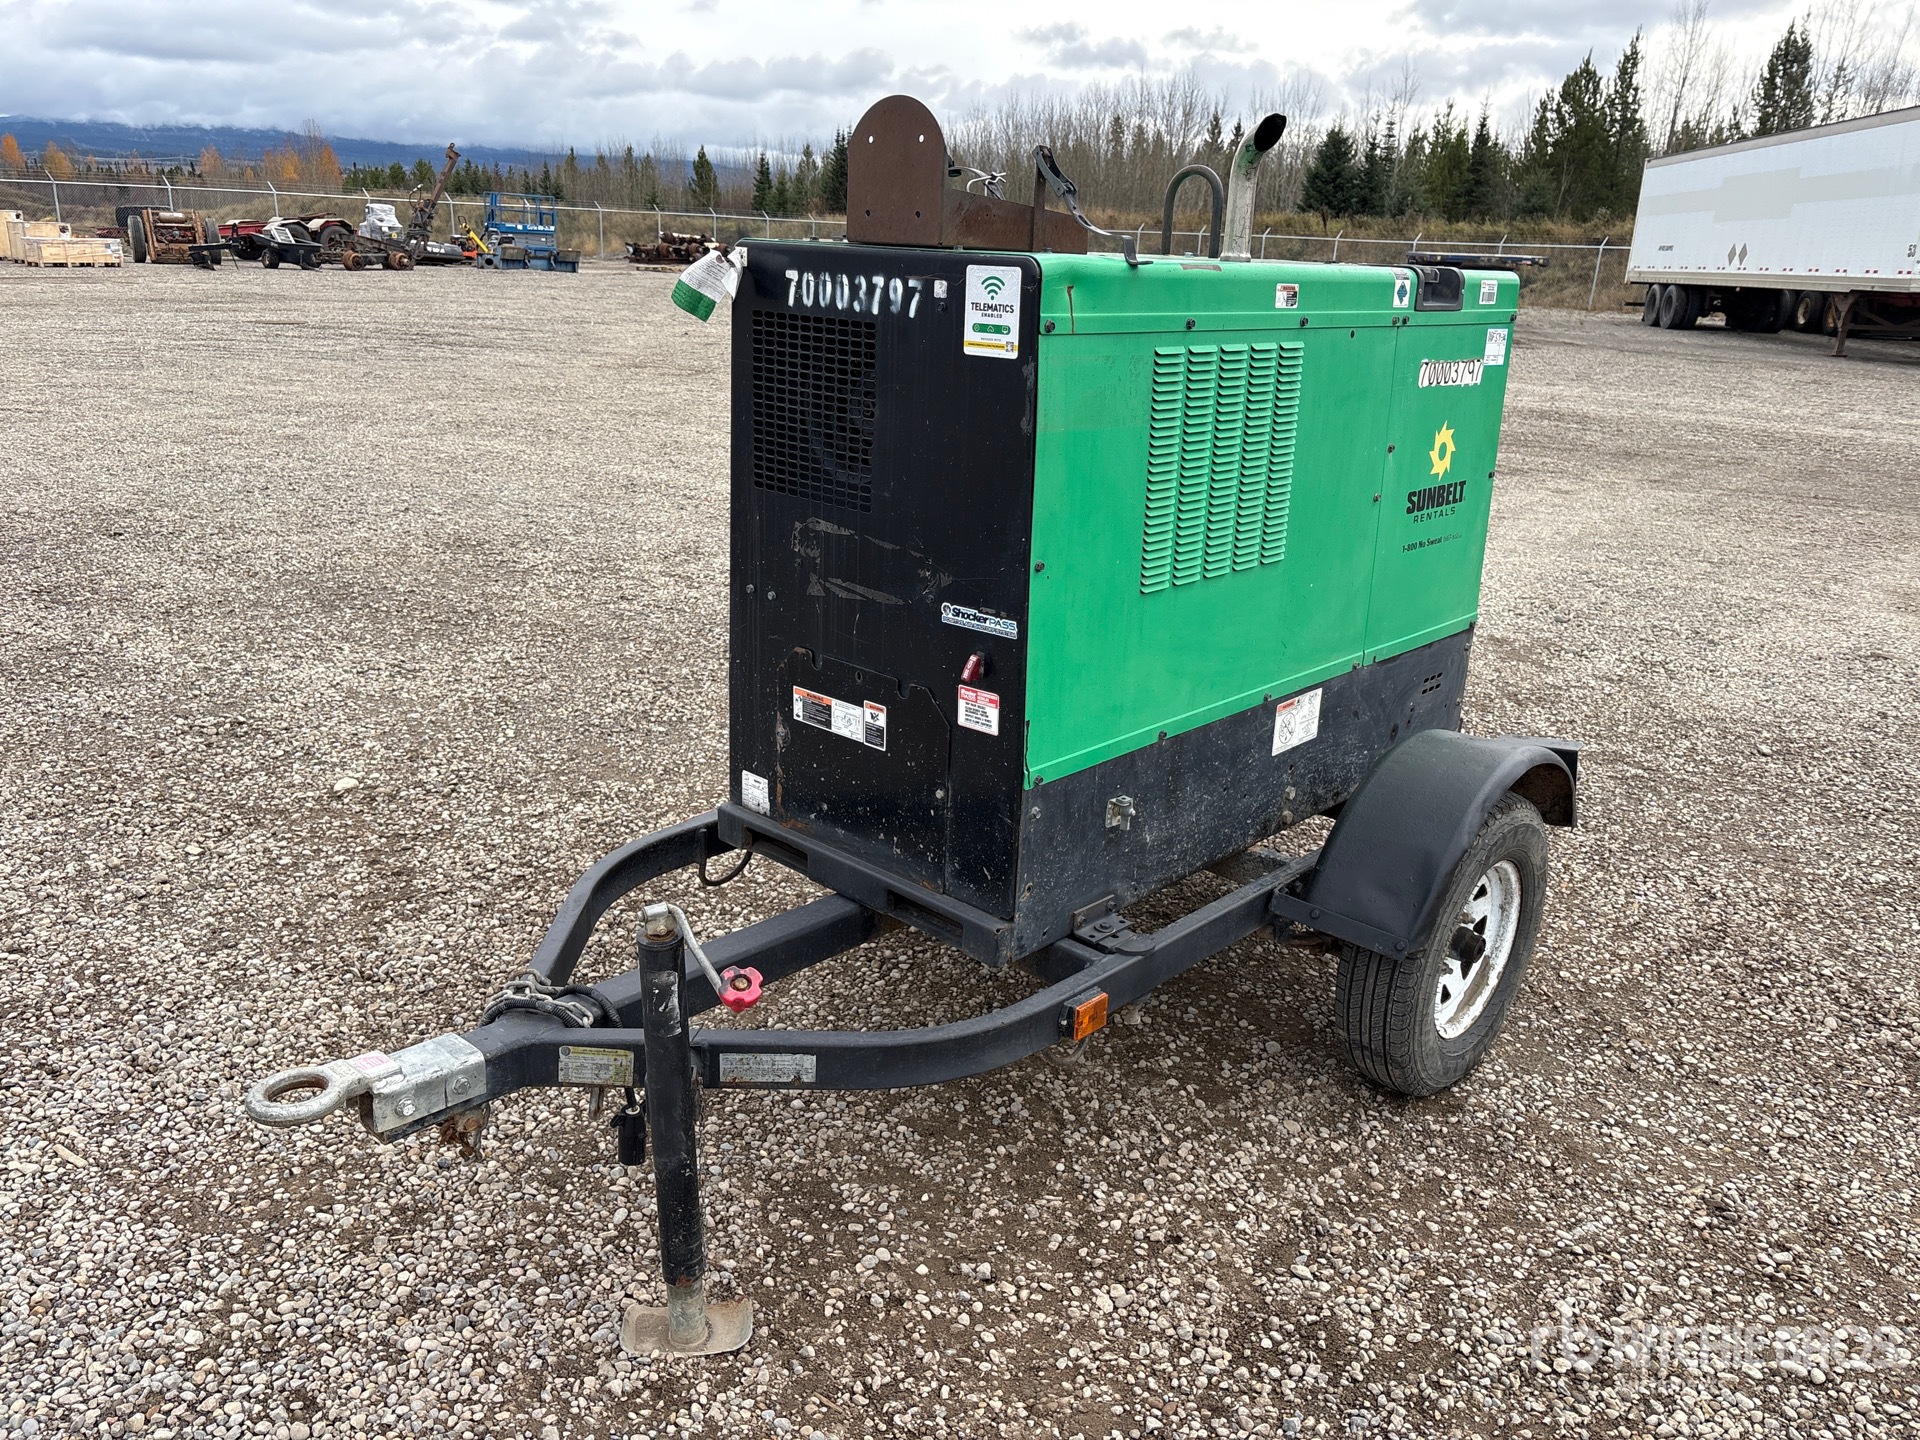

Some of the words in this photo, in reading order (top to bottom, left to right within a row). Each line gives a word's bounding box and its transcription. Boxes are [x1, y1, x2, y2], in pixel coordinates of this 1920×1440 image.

[785, 269, 923, 319] 70003797
[971, 302, 1015, 314] TELEMATICS
[1420, 359, 1484, 387] 70003797
[1406, 480, 1467, 515] SUNBELT
[1413, 507, 1456, 525] RENTALS
[1402, 541, 1418, 554] 1-800
[1427, 536, 1443, 547] Sweat
